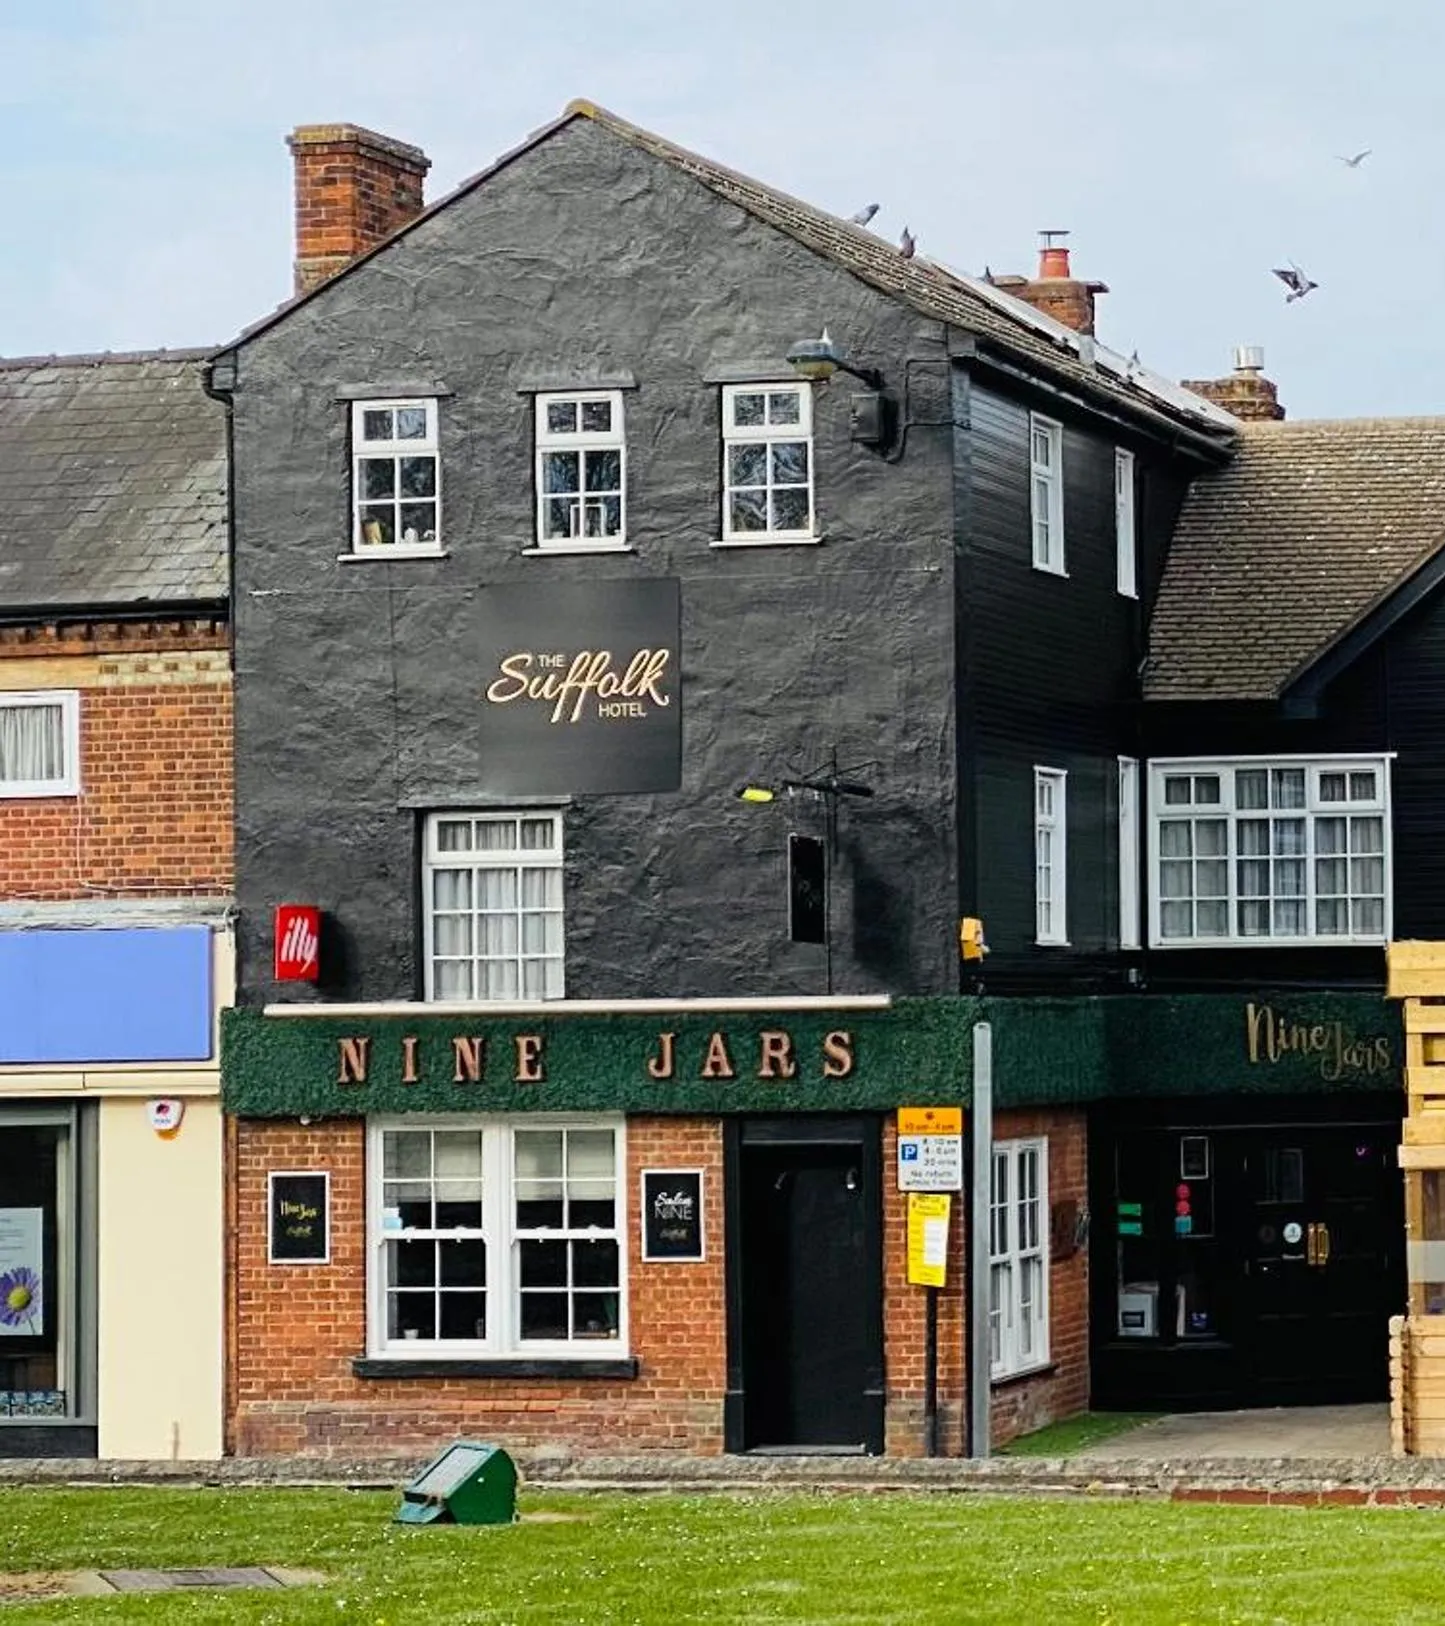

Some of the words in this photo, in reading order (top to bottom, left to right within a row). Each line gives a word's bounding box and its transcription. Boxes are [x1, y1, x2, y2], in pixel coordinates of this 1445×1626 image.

[538, 654, 567, 668] THE
[486, 648, 670, 724] Suffolk
[598, 702, 648, 718] HOTEL
[281, 916, 318, 973] illy
[337, 1035, 543, 1084] NINE
[649, 1030, 854, 1079] JARS
[1246, 1002, 1329, 1064] Nine
[1321, 1021, 1391, 1083] Jars
[904, 1145, 916, 1159] P
[654, 1205, 693, 1220] NINE
